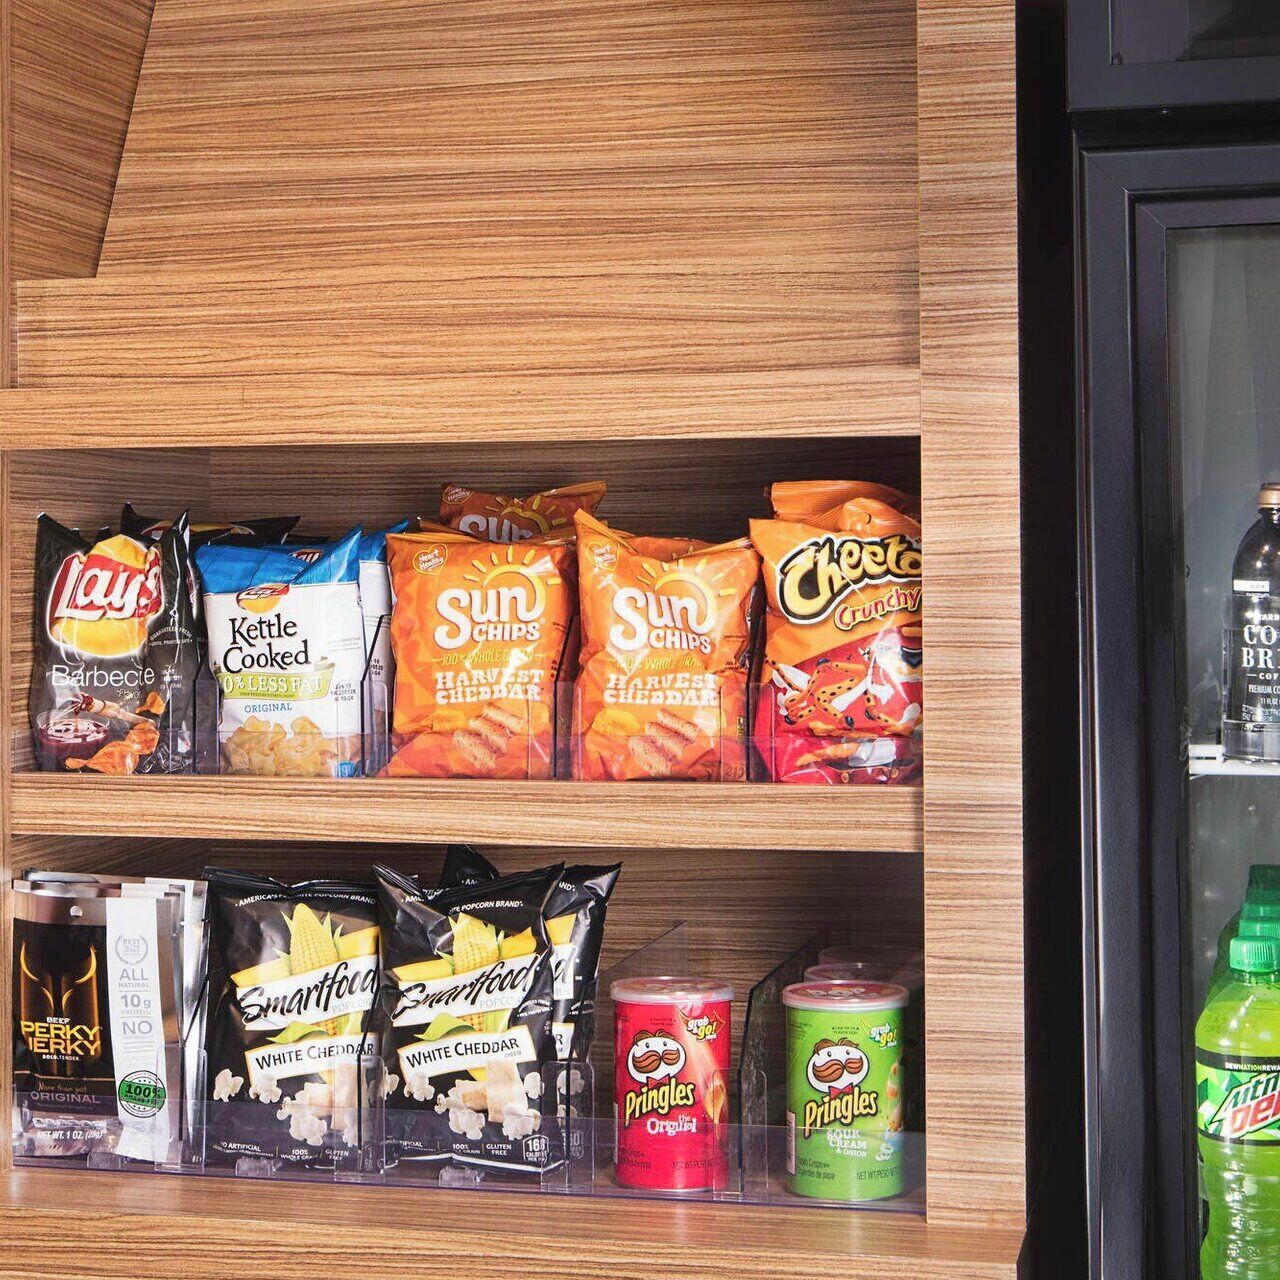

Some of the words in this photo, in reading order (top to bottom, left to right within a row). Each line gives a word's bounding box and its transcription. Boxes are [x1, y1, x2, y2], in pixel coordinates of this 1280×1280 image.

[54, 555, 161, 618] Lay's
[434, 574, 545, 650] Sun
[835, 587, 922, 630] Crunchy
[609, 586, 717, 652] Sun
[228, 612, 297, 646] Kettle
[472, 623, 541, 642] CHIPS
[648, 629, 713, 655] CHIPS
[223, 639, 311, 674] Cooked
[51, 664, 155, 687] Barbecue
[248, 678, 288, 693] LESS
[290, 676, 323, 693] FAT
[435, 670, 544, 689] HARVEST
[435, 686, 544, 705] CHEDDAR
[1248, 684, 1272, 694] PREMIUM
[244, 703, 293, 714] ORIGINAL
[120, 968, 149, 981] ALL
[239, 963, 378, 1023] Smartfood
[394, 954, 540, 1018] Smartfood
[121, 994, 141, 1008] 10
[21, 1021, 100, 1038] PERKY
[46, 1016, 70, 1024] BEEF
[122, 1019, 153, 1036] NO
[255, 1048, 304, 1070] WHITE
[307, 1044, 374, 1060] CHEDDAR
[30, 1091, 101, 1104] ORIGINAL
[124, 1082, 160, 1098] 100%
[625, 1077, 695, 1128] Pringles
[803, 1089, 878, 1139] Pringles
[829, 1139, 867, 1149] CREAM
[843, 1149, 867, 1157] ONION
